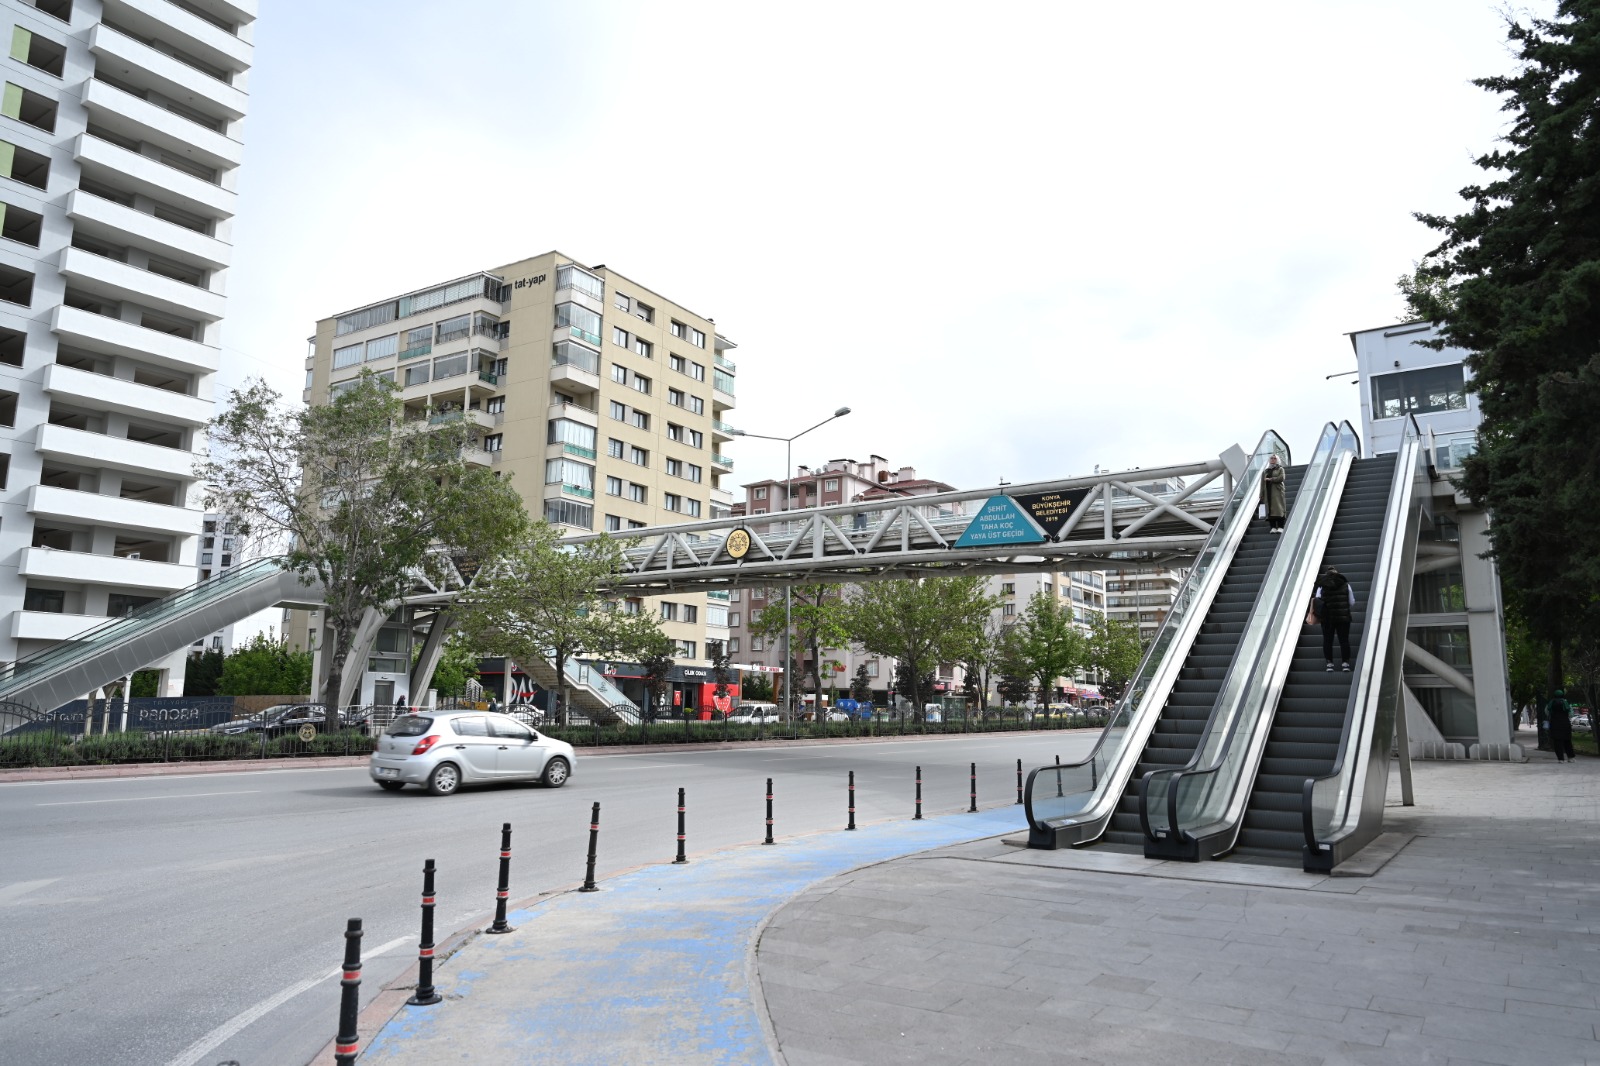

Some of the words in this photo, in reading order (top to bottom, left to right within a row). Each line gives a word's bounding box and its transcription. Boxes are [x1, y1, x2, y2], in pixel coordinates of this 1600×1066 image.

[514, 274, 546, 289] tat-yapı
[987, 504, 1007, 514] ŞEHİT
[1031, 500, 1072, 510] BÜYÜKŞEHİR
[1035, 507, 1068, 517] BELEDİYESİ
[979, 513, 1016, 522] ABDULLAH
[1000, 522, 1014, 530] KOÇ
[970, 532, 986, 540] YAYA
[987, 530, 1001, 539] ÜST
[1002, 528, 1025, 538] GEÇİDİ
